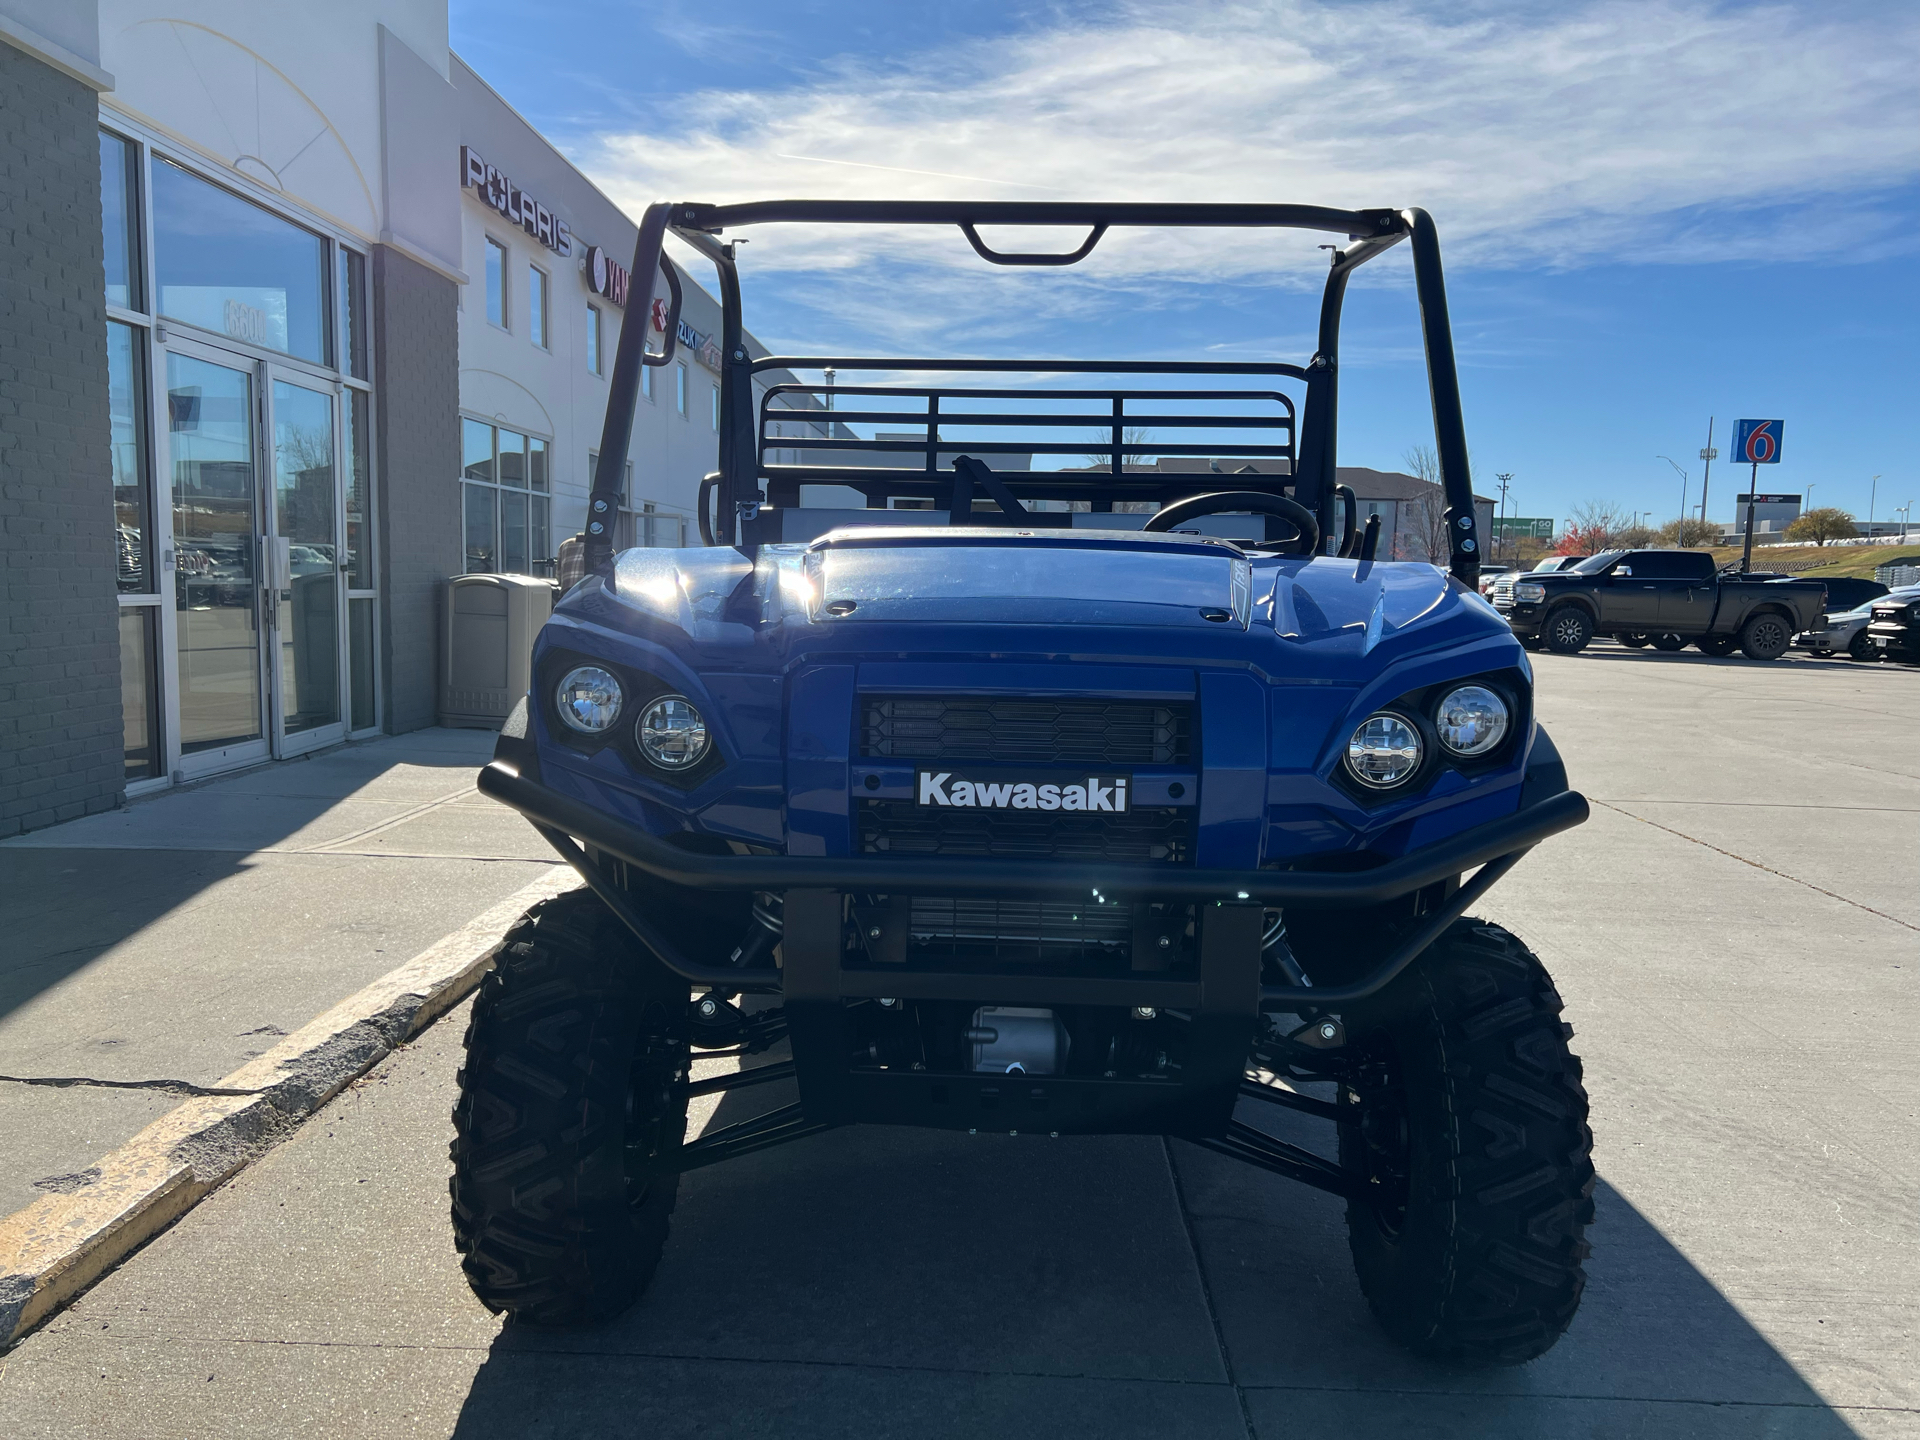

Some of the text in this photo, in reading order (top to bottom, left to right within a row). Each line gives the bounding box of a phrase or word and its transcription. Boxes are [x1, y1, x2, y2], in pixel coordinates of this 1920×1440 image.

[464, 145, 573, 258] POLARIS
[608, 257, 630, 307] YAM
[1745, 420, 1776, 462] 6
[1235, 560, 1248, 586] FXR
[919, 772, 1127, 812] Kawasaki
